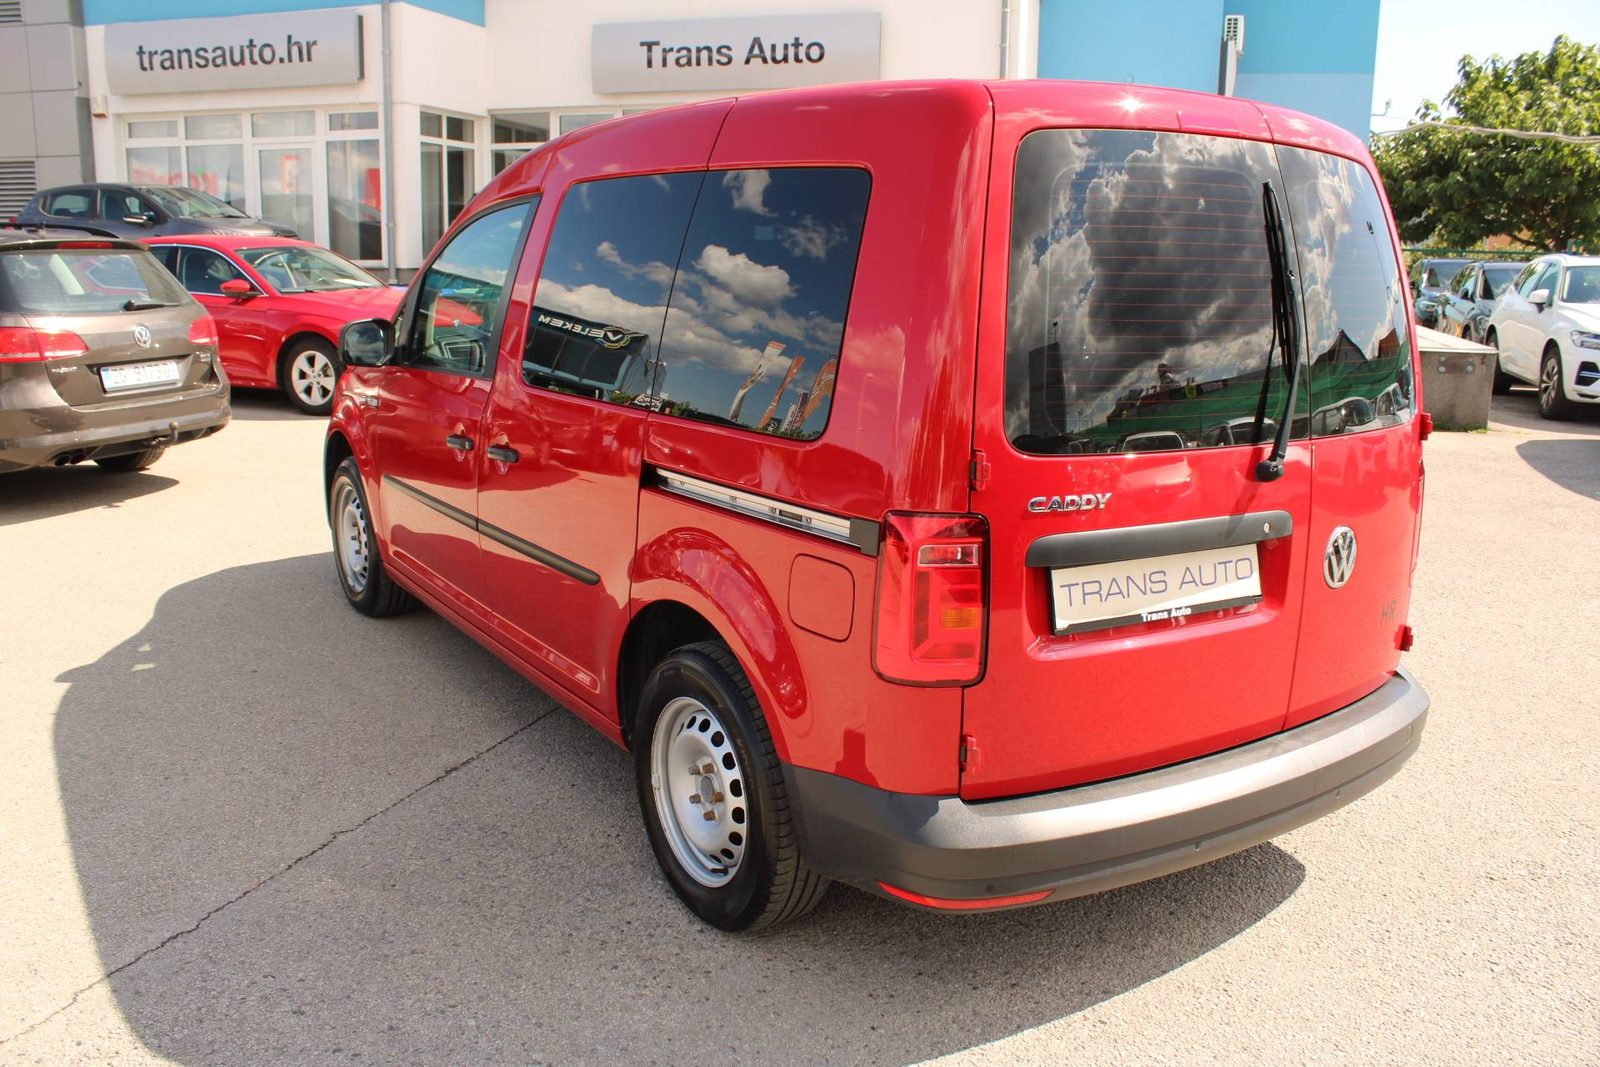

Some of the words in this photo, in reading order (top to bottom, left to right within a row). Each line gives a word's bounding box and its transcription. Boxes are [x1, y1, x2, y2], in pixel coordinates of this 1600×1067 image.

[136, 35, 318, 72] transauto.hr
[639, 40, 733, 69] Trans
[743, 37, 826, 65] Auto
[1028, 491, 1112, 513] CADDY
[1059, 569, 1168, 607] TRANS
[1179, 557, 1255, 589] AUTO
[1141, 612, 1169, 623] Trans
[1171, 607, 1192, 618] Auto
